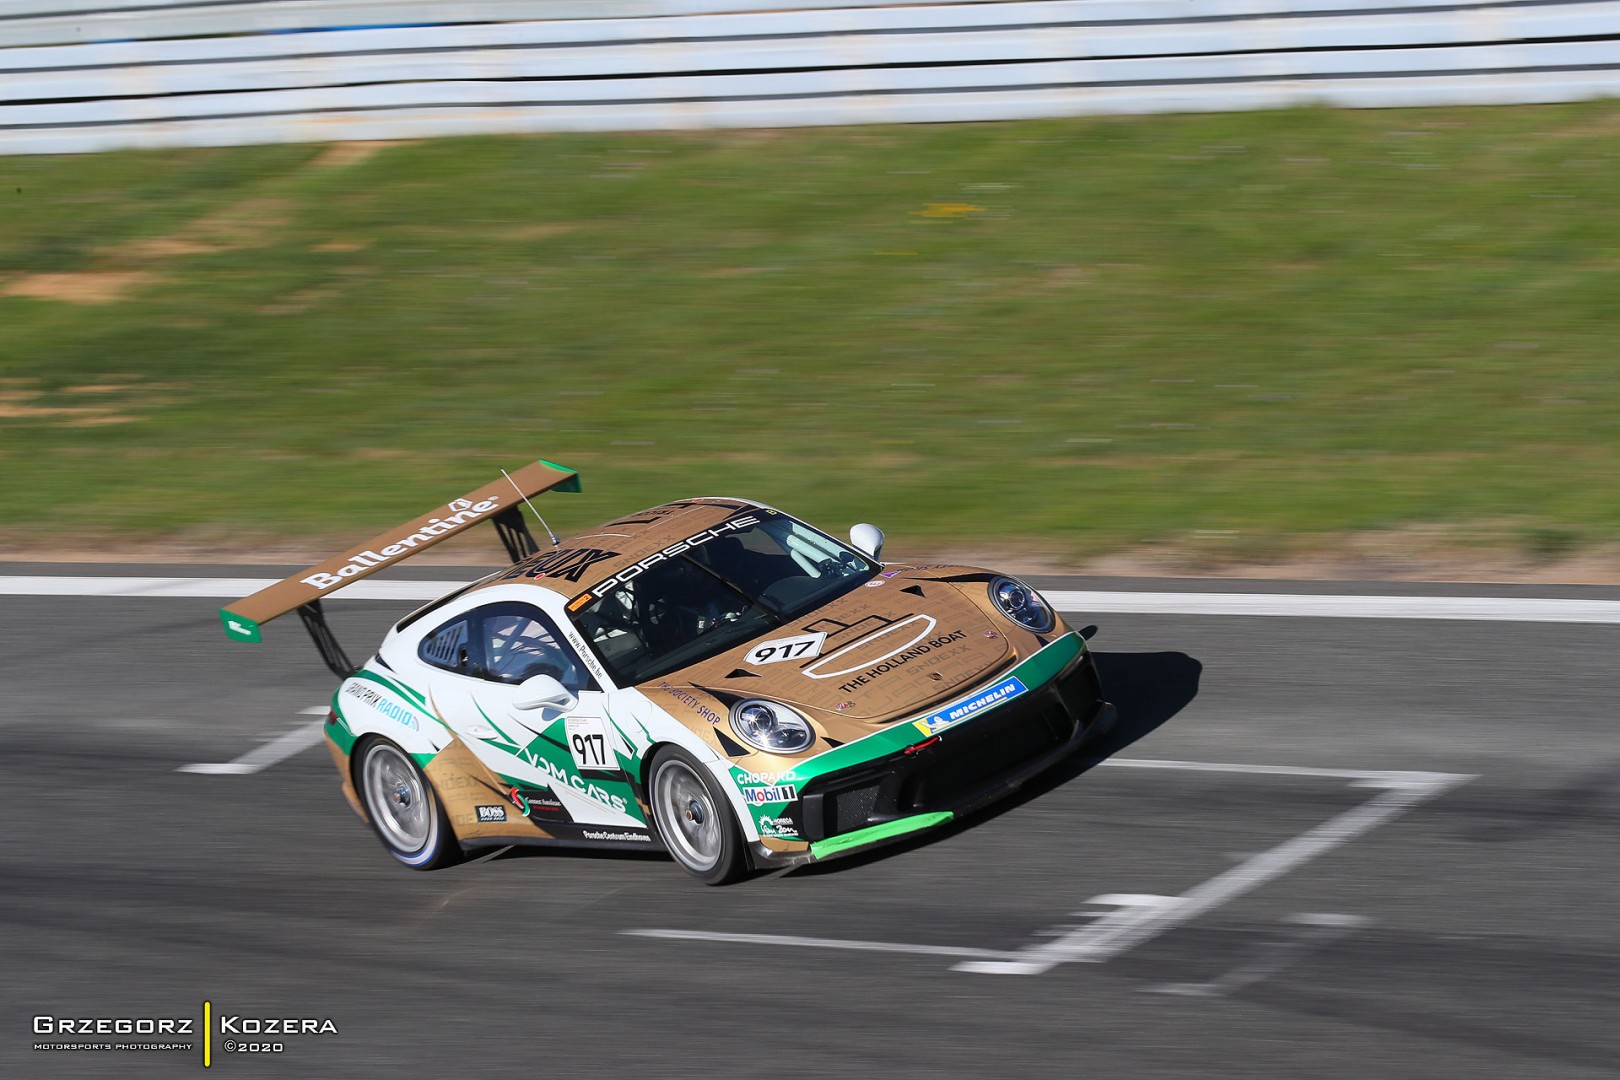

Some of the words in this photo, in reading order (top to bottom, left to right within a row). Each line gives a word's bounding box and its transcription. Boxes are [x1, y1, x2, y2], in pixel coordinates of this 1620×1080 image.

[300, 499, 499, 589] Ballentine
[592, 515, 760, 598] PORSCHE
[755, 641, 816, 662] 917
[838, 675, 871, 693] THE
[866, 645, 931, 678] HOLLAND
[928, 630, 967, 648] BOAT
[360, 689, 383, 709] PRIX
[376, 698, 413, 726] RADIO
[668, 687, 701, 709] SOCIETY
[697, 705, 721, 725] SHOP
[949, 684, 1016, 719] MICHELIN
[573, 734, 606, 765] 917
[570, 775, 627, 813] CARS
[737, 771, 796, 784] CHOPARD
[745, 788, 781, 802] Mobil
[479, 806, 504, 818] BOSS
